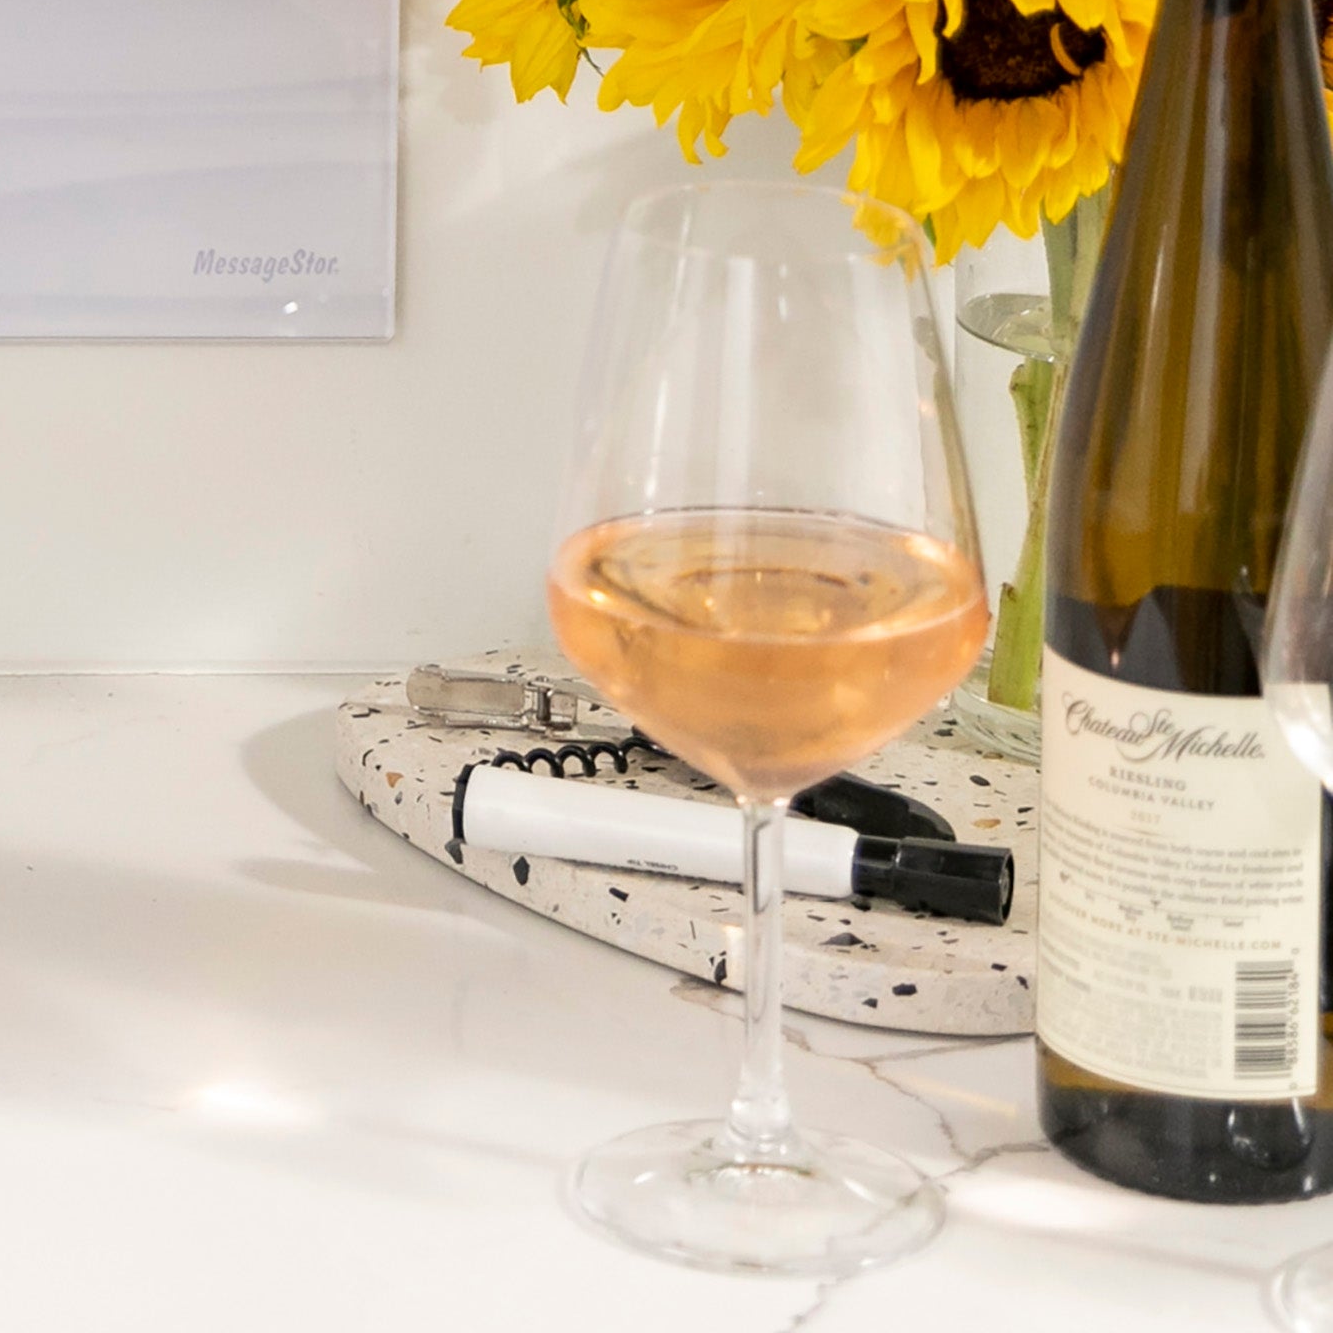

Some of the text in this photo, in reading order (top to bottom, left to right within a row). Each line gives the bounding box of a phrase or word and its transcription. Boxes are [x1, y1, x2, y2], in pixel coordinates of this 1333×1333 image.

[1062, 691, 1148, 746] Chateau
[1087, 774, 1216, 812] COLUMBIA VALLEY
[1109, 765, 1187, 792] RIESLING
